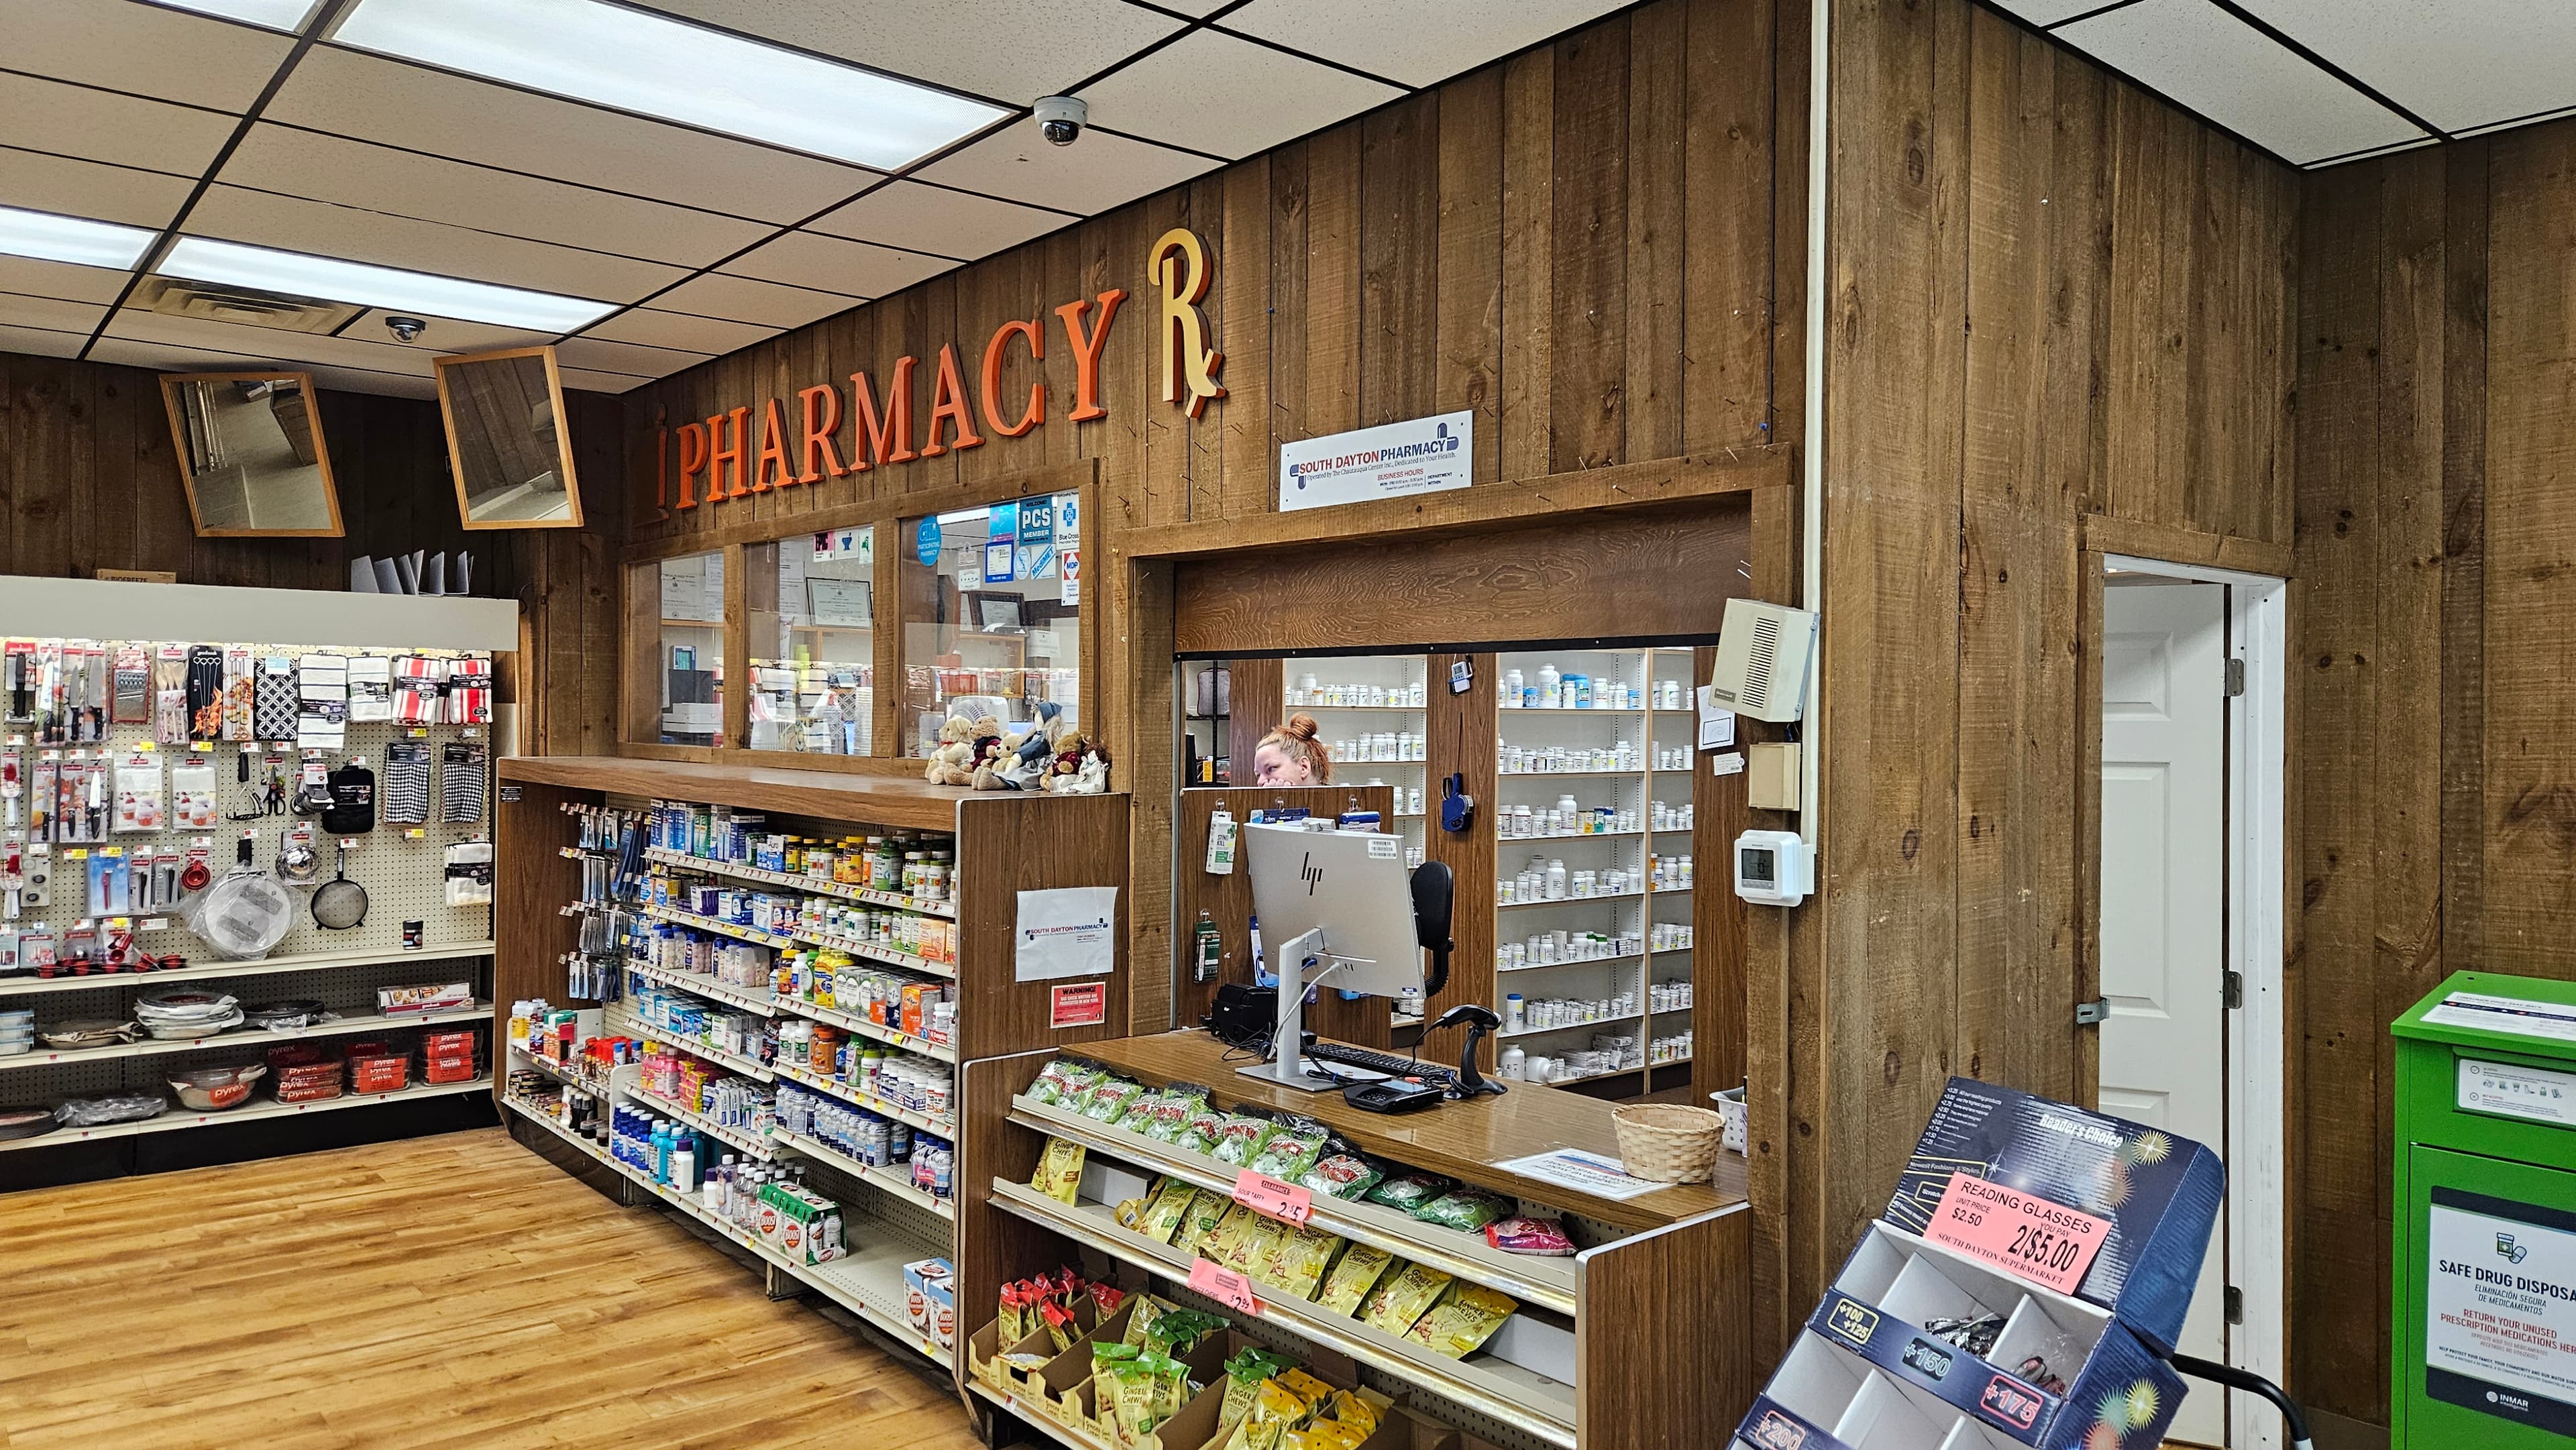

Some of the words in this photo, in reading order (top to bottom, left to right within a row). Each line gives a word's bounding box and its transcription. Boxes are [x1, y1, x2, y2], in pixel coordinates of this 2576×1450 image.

[676, 288, 1129, 509] PHARMACY
[1299, 458, 1332, 474] SOUTH
[1336, 450, 1379, 469] DAYTON
[1381, 439, 1446, 461] PHARMACY
[1307, 471, 1327, 481] Operated
[1341, 465, 1367, 476] Chautauqua
[1368, 463, 1383, 471] Center
[1395, 457, 1419, 467] Dedicated
[1438, 451, 1456, 460] Health.
[1377, 471, 1403, 481] BUSINESS
[1404, 467, 1424, 477] HOURS
[1022, 508, 1051, 529] PCS
[816, 532, 828, 552] EPIC
[1023, 530, 1049, 539] MEMBER
[1066, 561, 1079, 569] MDP
[1062, 986, 1096, 995] WARNING!
[441, 1032, 462, 1041] pyrex
[268, 1044, 296, 1056] pyrex
[439, 1042, 460, 1052] pyrex
[374, 1058, 396, 1067] pyrex
[215, 1083, 246, 1098] pyrex
[287, 1089, 317, 1099] pyrex
[1985, 1097, 2002, 1105] products
[2039, 1113, 2086, 1138] Reader's
[2084, 1126, 2124, 1148] Choice
[1931, 1163, 1955, 1171] Fashions
[1238, 1188, 1250, 1196] SOUR
[1250, 1192, 1265, 1201] TAFFY
[1261, 1180, 1291, 1195] CLEARANCE
[1956, 1197, 1971, 1208] UNIT
[1971, 1201, 1991, 1214] PRICE
[1961, 1181, 2019, 1209] READING
[2023, 1202, 2092, 1234] GLASSES
[759, 1215, 776, 1226] BOOST
[1952, 1207, 1982, 1227] $2.50
[784, 1229, 800, 1240] BOOST
[1254, 1221, 1279, 1234] CHEWS
[2041, 1222, 2057, 1233] YOU
[2056, 1228, 2072, 1239] PAY
[1294, 1232, 1318, 1245] CHEWS
[2008, 1225, 2080, 1272] 2/$5.00
[1348, 1254, 1371, 1266] CHEWS
[1352, 1249, 1381, 1264] GINGER
[1937, 1233, 1964, 1249] SOUTH
[1965, 1242, 1998, 1261] DAYTON
[1999, 1255, 2065, 1285] SUPERMARKET
[2439, 1260, 2472, 1278] SAFE
[2475, 1268, 2512, 1288] DRUG
[2517, 1277, 2576, 1302] DISPOSA
[910, 1294, 922, 1304] BOOST
[2475, 1284, 2518, 1300] ELIMINACIÓN
[2520, 1294, 2547, 1308] SEGURA
[2478, 1294, 2487, 1302] DE
[2489, 1296, 2543, 1316] MEDICAMENTOS
[1839, 1304, 1864, 1324] +100
[1843, 1319, 1870, 1340] +125
[2463, 1308, 2496, 1325] RETURN
[2498, 1317, 2521, 1329] YOUR
[2522, 1323, 2557, 1339] UNUSED
[2440, 1313, 2498, 1336] PRESCRIPTION
[2501, 1327, 2558, 1350] MEDICATIONS
[2560, 1344, 2576, 1355] HER
[1905, 1343, 1951, 1378] +150
[2449, 1348, 2467, 1356] PROTECT
[2506, 1363, 2531, 1374] COMMUNITY
[2551, 1374, 2565, 1382] WATER
[1122, 1394, 1143, 1404] CHEWS
[1228, 1394, 1248, 1408] CHEWS
[1986, 1385, 2038, 1423] +175
[2500, 1394, 2529, 1407] INMAR
[1760, 1418, 1801, 1450] +200
